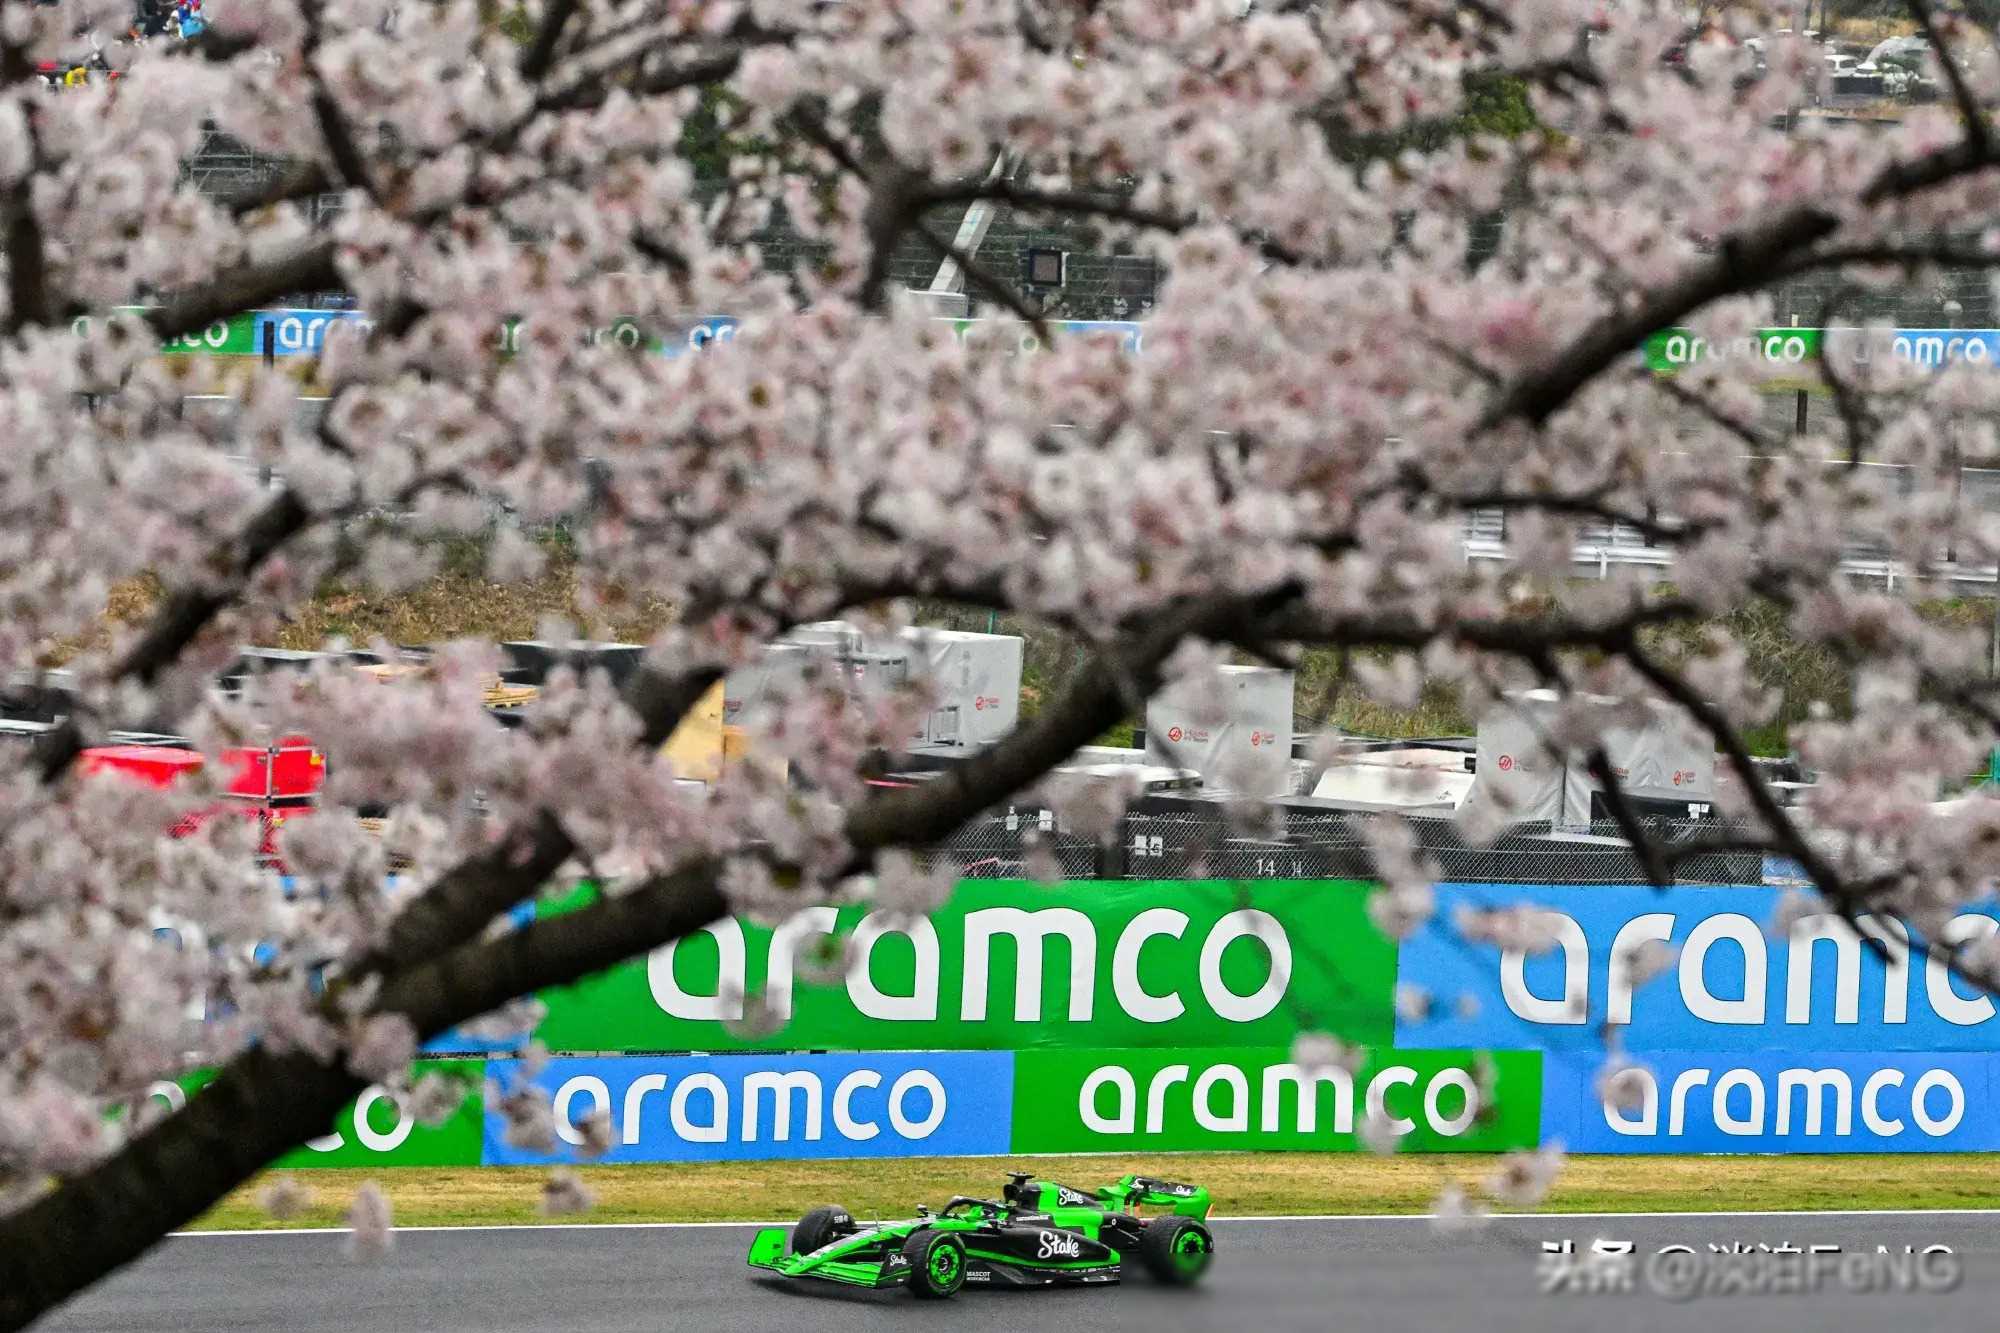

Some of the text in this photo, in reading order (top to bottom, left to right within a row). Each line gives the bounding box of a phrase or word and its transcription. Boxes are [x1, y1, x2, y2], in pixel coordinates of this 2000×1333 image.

[647, 906, 1293, 1023] aramco
[553, 1068, 947, 1146] aramco
[1079, 1064, 1479, 1137] aramco
[1603, 1067, 1965, 1137] aramco
[1058, 1187, 1084, 1205] Stake
[1037, 1230, 1080, 1259] Stake
